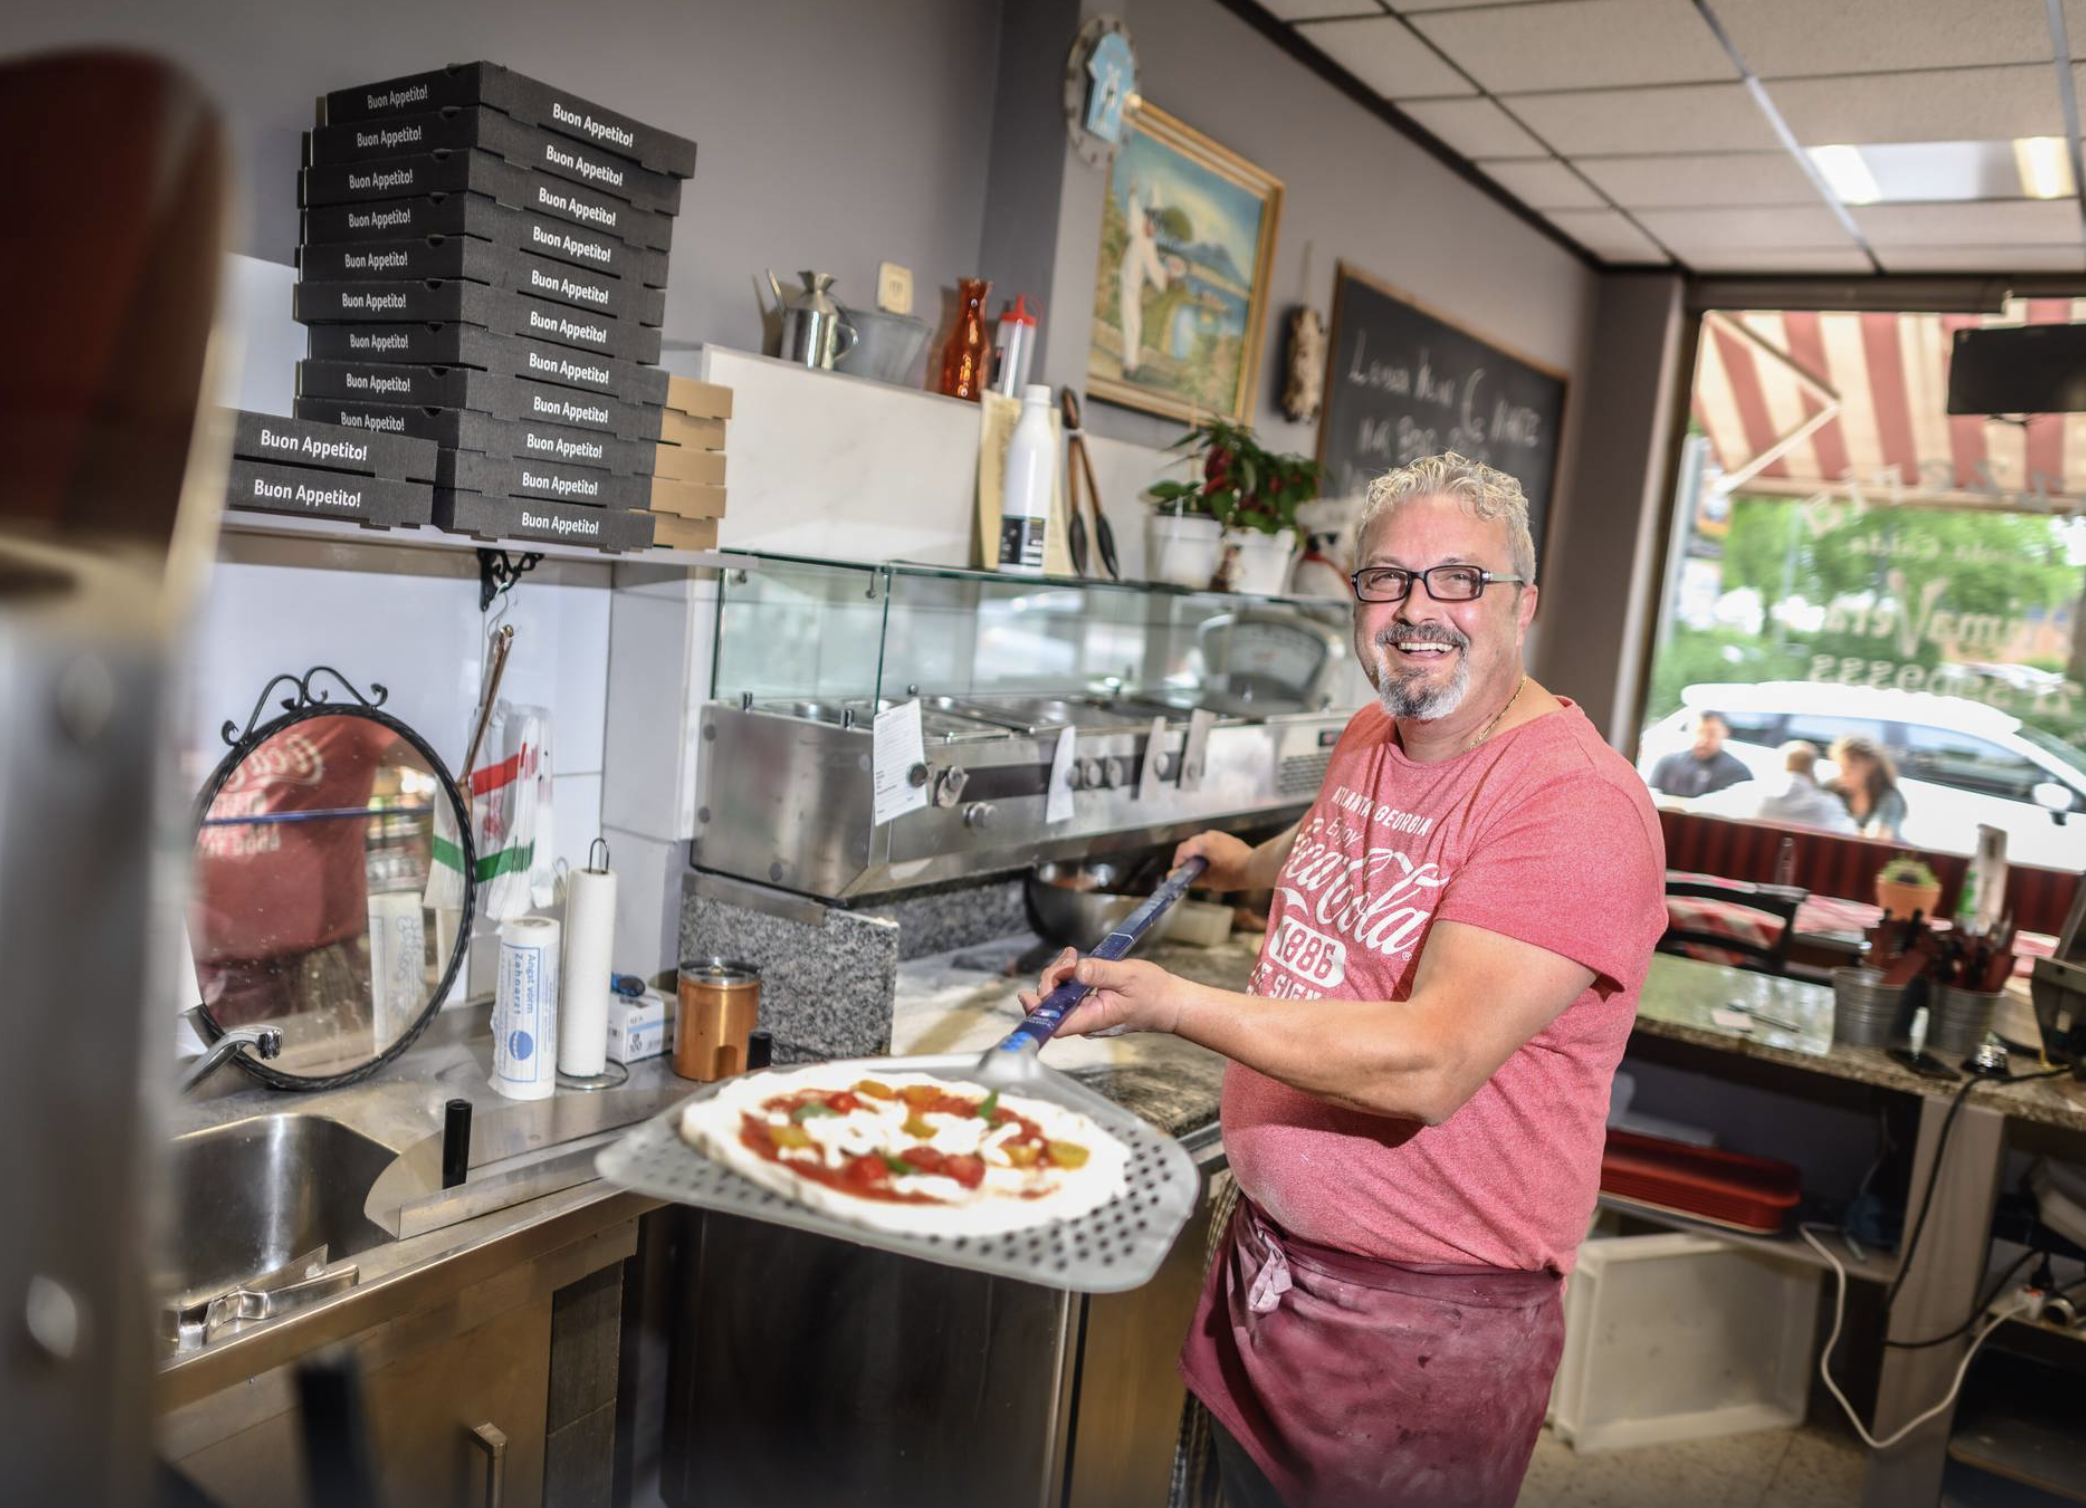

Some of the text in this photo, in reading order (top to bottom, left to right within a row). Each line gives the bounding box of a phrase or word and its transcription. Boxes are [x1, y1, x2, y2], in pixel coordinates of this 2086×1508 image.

[367, 83, 428, 110] Buon Appetito!
[356, 125, 422, 148] Buon Appetito!
[552, 102, 634, 148] Buon Appetito!
[348, 168, 414, 190] Buon Appetito!
[546, 144, 623, 187] Buon Appetito!
[348, 208, 411, 228] Buon Appetito!
[538, 186, 617, 227] Buon Appetito!
[532, 225, 612, 263] Buon Appetito!
[344, 251, 408, 271] Buon Appetito!
[531, 269, 609, 305] Buon Appetito!
[341, 292, 407, 314] Buon Appetito!
[530, 310, 607, 344] Buon Appetito!
[349, 333, 409, 352] Buon Appetito!
[529, 352, 610, 385] Buon Appetito!
[346, 372, 411, 394] Buon Appetito!
[340, 411, 405, 434] Buon Appetito!
[533, 395, 609, 424] Buon Appetito!
[260, 429, 368, 461] Buon Appetito!
[526, 433, 603, 459] Buon Appetito!
[254, 478, 361, 508] Buon Appetito!
[522, 471, 598, 496] Buon Appetito!
[521, 511, 599, 535] Buon Appetito!
[1374, 805, 1434, 837] GEORGIA
[1275, 920, 1337, 980] 1886
